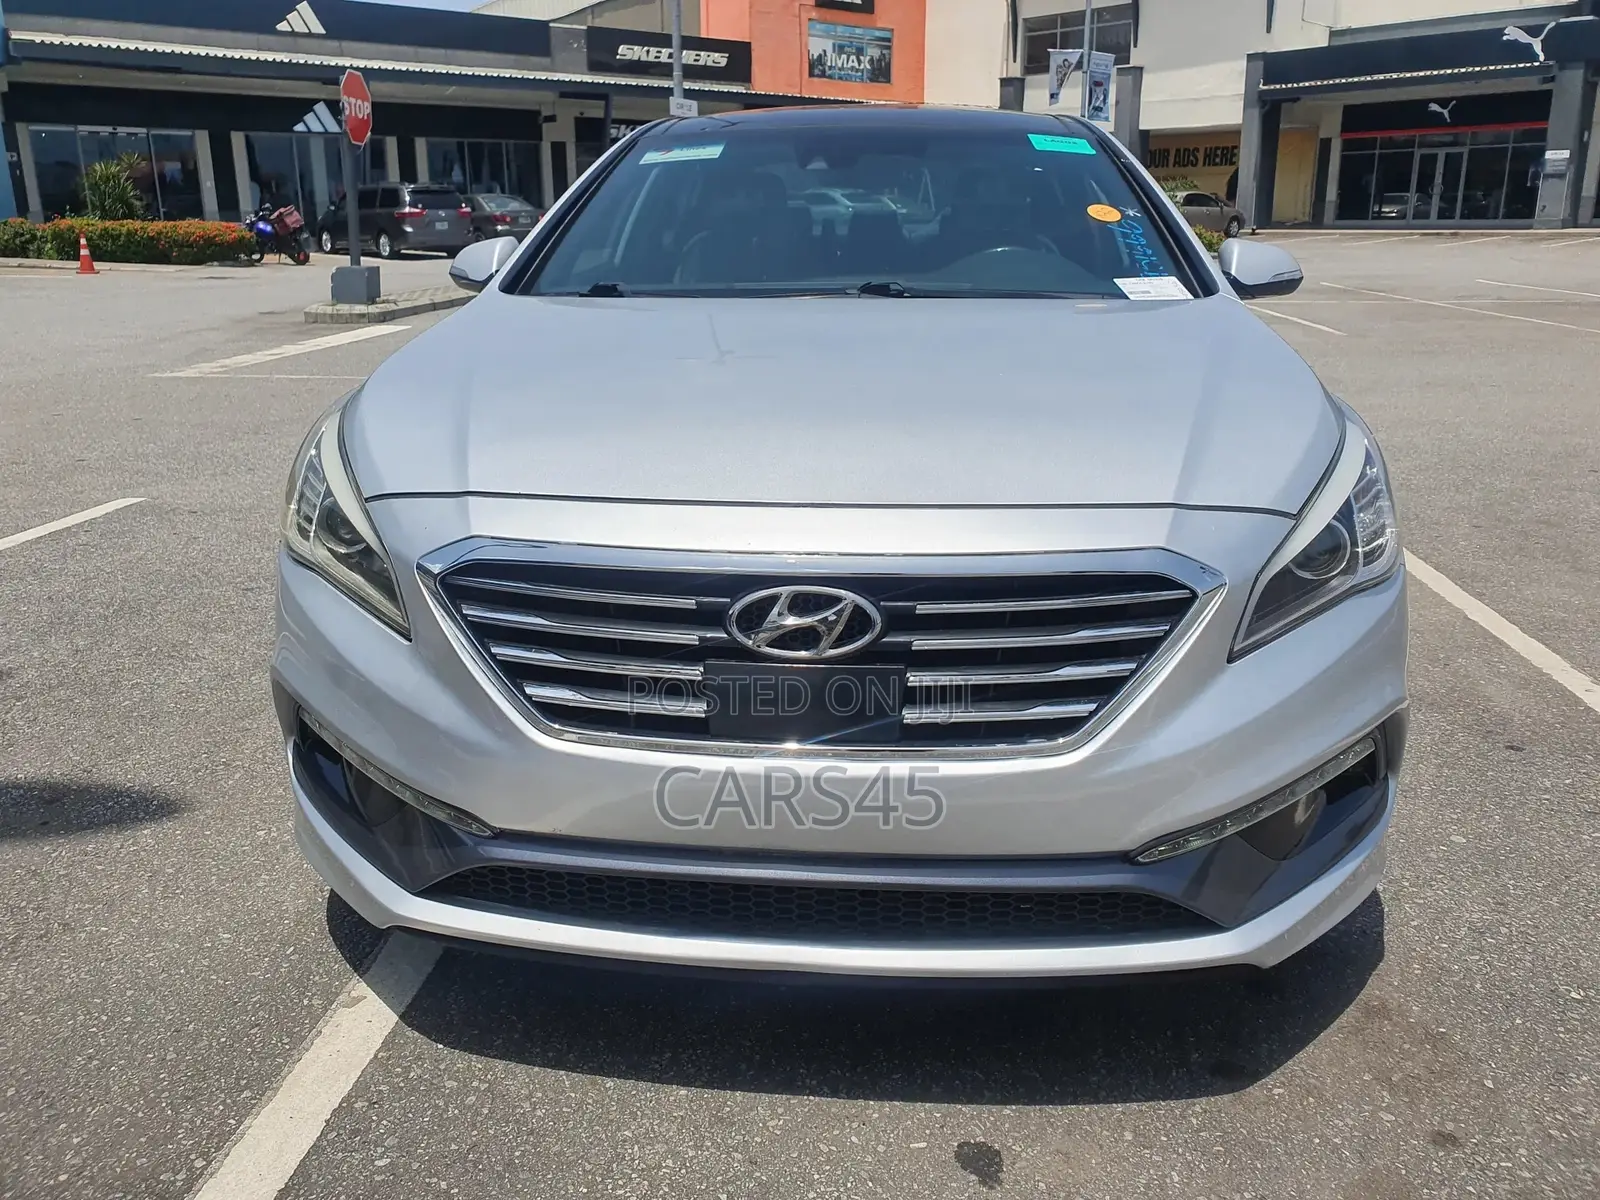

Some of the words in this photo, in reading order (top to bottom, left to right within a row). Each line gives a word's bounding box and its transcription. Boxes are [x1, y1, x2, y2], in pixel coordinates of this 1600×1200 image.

[827, 53, 871, 69] IMAX
[342, 95, 370, 119] STOP
[1172, 146, 1200, 168] ADS
[1203, 144, 1238, 167] HERE
